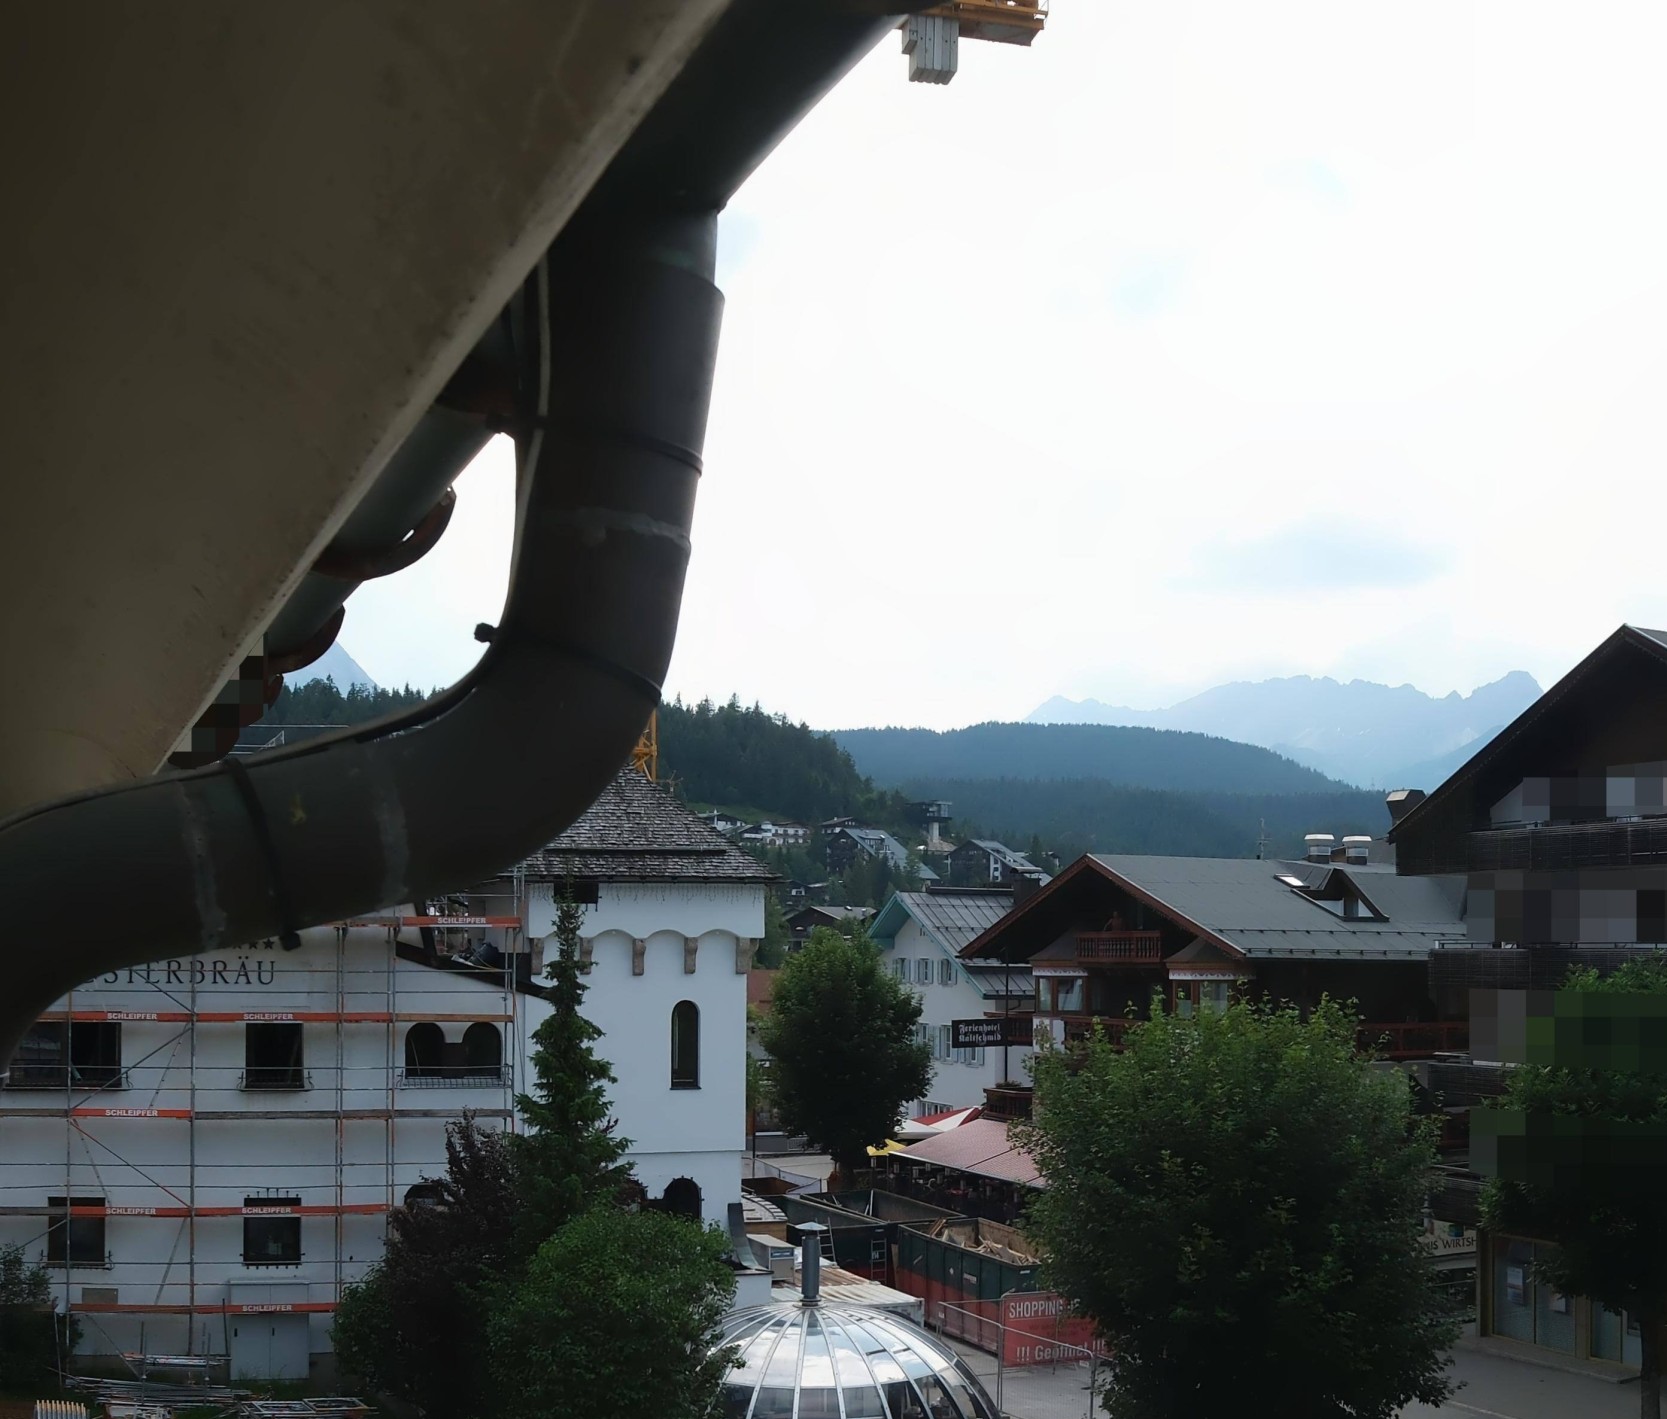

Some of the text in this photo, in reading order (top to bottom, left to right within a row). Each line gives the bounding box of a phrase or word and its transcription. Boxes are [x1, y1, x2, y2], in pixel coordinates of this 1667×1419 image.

[437, 917, 487, 925] SCHLEIPFER
[86, 956, 276, 985] STERBRÄU
[107, 1013, 157, 1021] SCHLEIPFER
[243, 1013, 293, 1021] SCHLEIPFER
[105, 1109, 158, 1117] SCHLEIPFER
[105, 1208, 156, 1216] SCHLEIPFER
[241, 1206, 292, 1214] SCHLEIPFER
[242, 1304, 292, 1312] SCHLEIPFER
